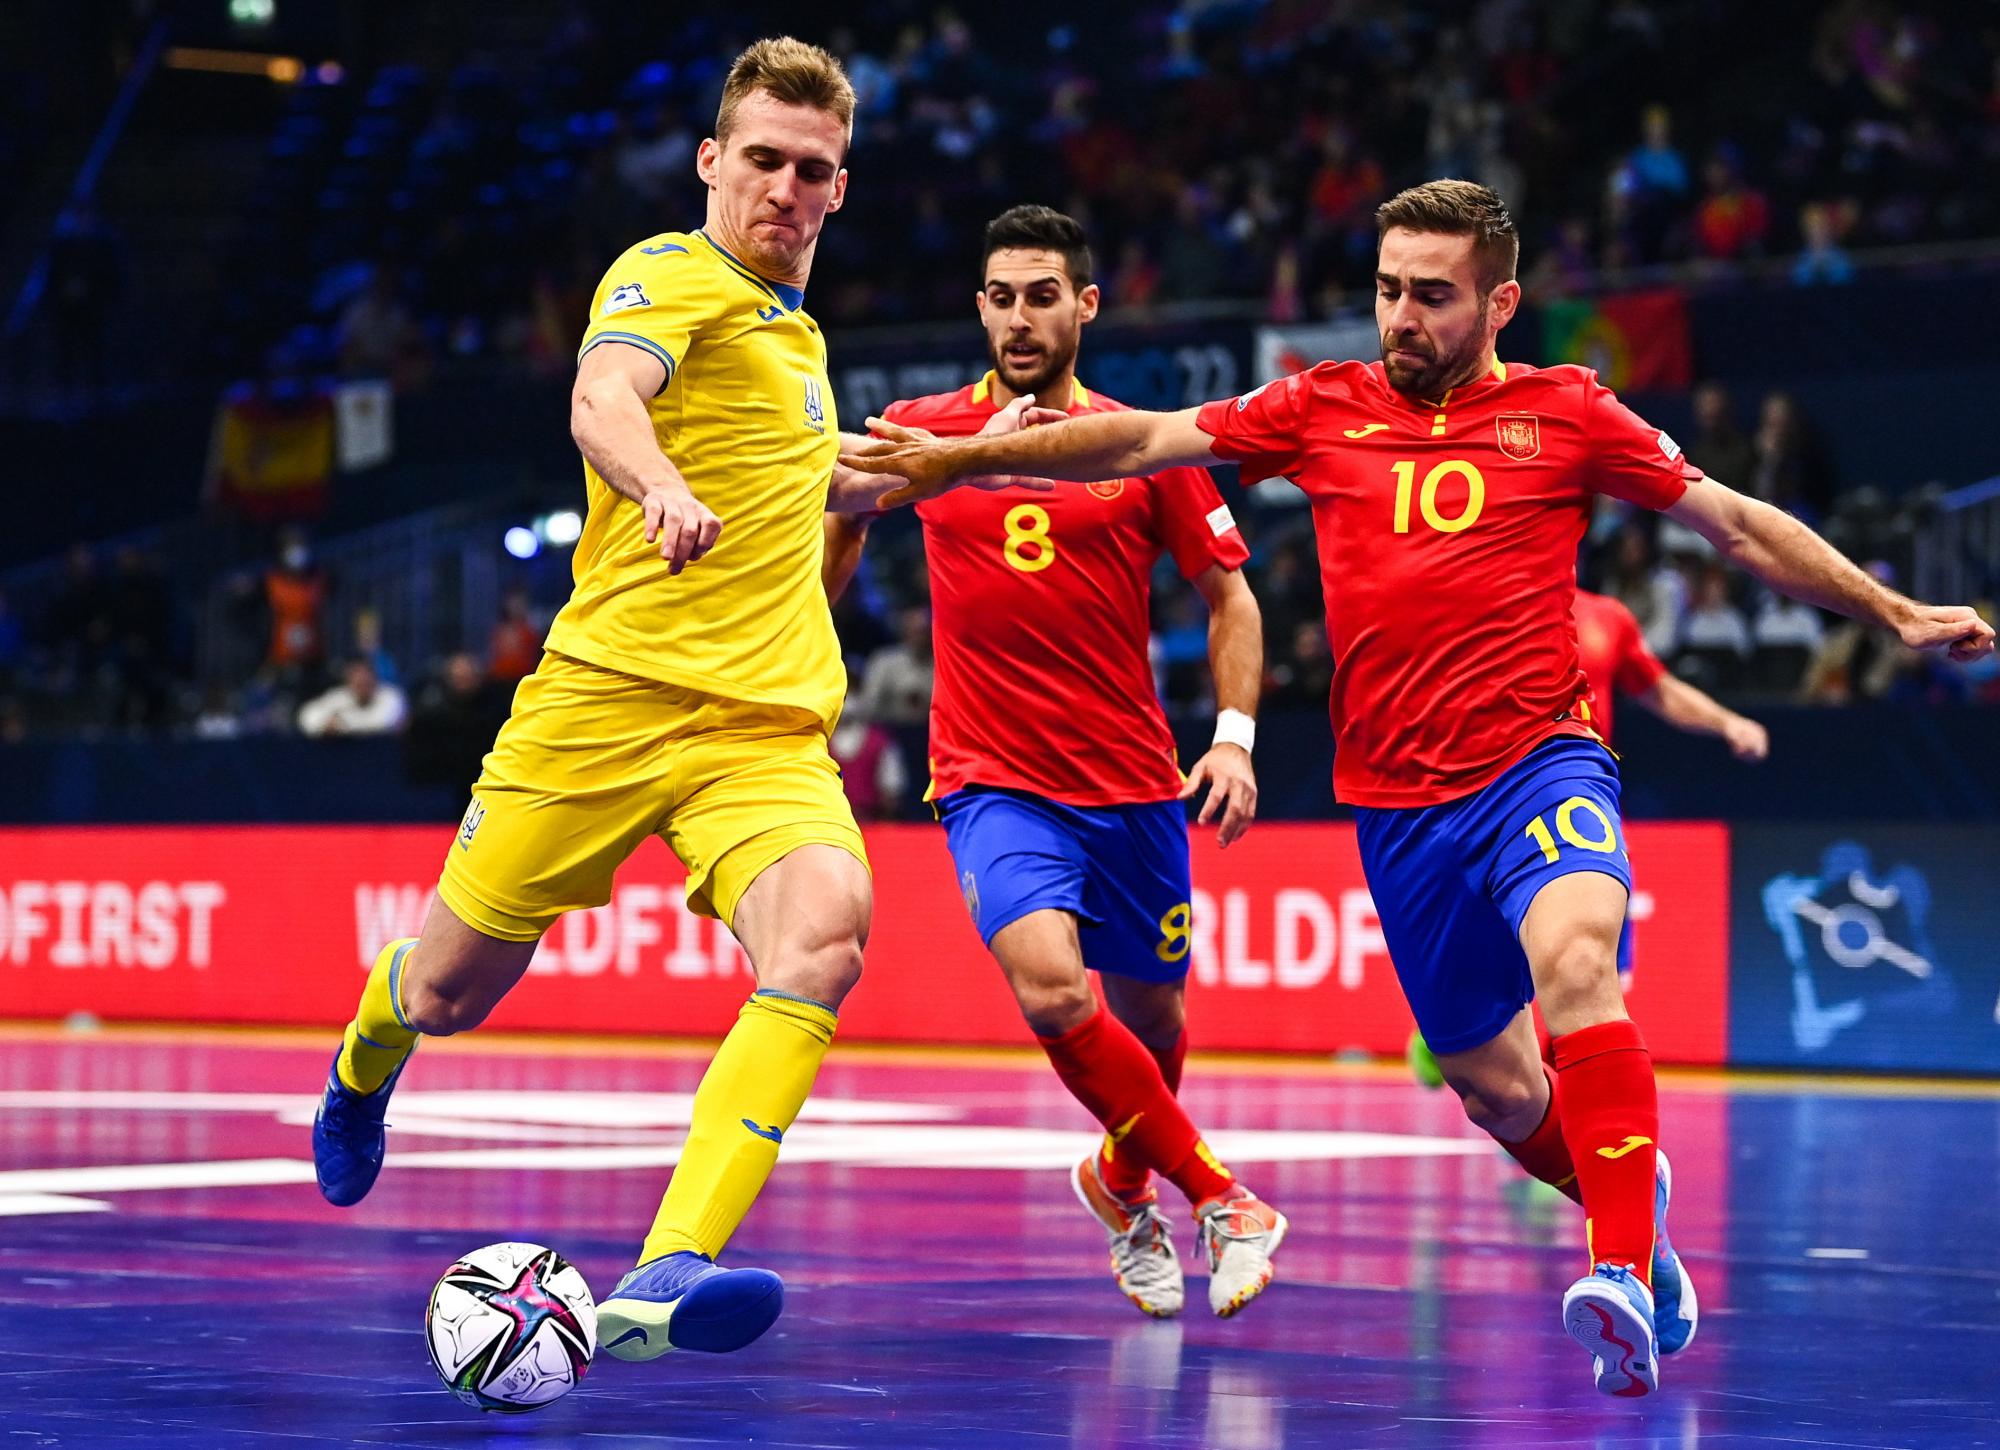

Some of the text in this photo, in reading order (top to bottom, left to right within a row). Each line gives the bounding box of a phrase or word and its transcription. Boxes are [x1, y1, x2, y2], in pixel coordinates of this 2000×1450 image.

[1390, 460, 1485, 533] 10
[1003, 503, 1056, 572] 8
[1525, 796, 1616, 864] 10
[0, 880, 227, 970] FIRST
[1155, 902, 1191, 962] 8
